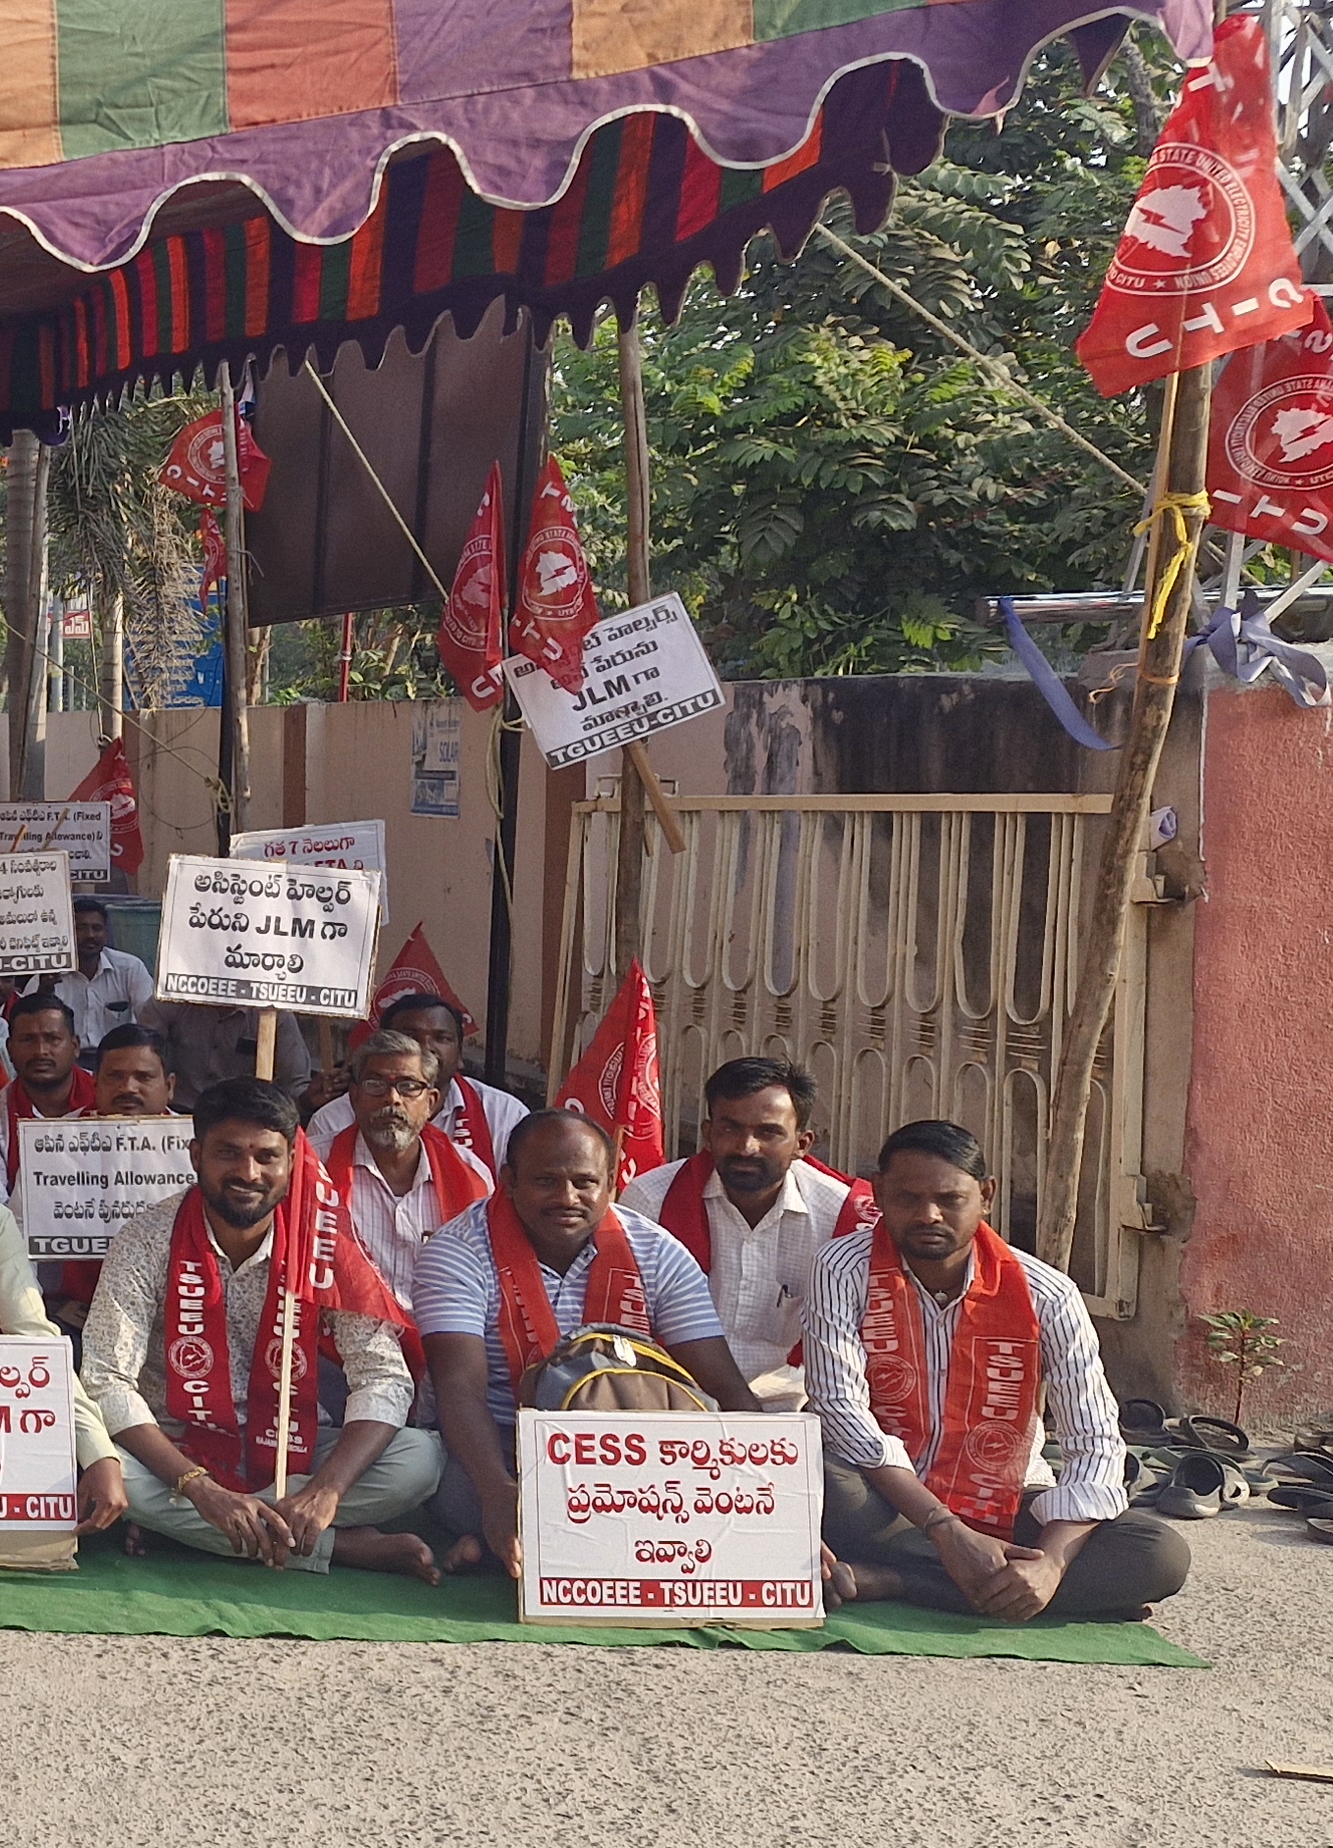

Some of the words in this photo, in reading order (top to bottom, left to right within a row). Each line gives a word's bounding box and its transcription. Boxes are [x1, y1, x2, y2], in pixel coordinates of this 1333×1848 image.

[1159, 148, 1195, 164] STATE
[1196, 152, 1231, 185] UNITED
[572, 674, 632, 712] JLM
[632, 666, 661, 686] గా
[551, 691, 715, 765] TGUEEU-CITU
[46, 831, 95, 842] Alowance)
[288, 840, 299, 855] 7
[255, 915, 315, 940] JLM
[320, 919, 348, 940] గా
[165, 973, 238, 997] NCCOEEE
[249, 981, 308, 1003] TSUEEU
[319, 988, 356, 1008] CITU
[161, 1134, 191, 1155] (Fix
[32, 1171, 109, 1189] Travelling
[18, 1408, 57, 1434] గా
[547, 1432, 647, 1467] CESS
[658, 1437, 800, 1481] కార్మికులకు
[25, 1495, 73, 1520] CITU
[566, 1480, 690, 1525] ప్రమోషన్స్
[694, 1481, 776, 1516] వెంటనే
[634, 1538, 713, 1575] ఇవ్వాలి
[541, 1579, 642, 1605] NCCOEEE
[662, 1580, 744, 1606] TSUEEU
[761, 1581, 812, 1607] CITU
